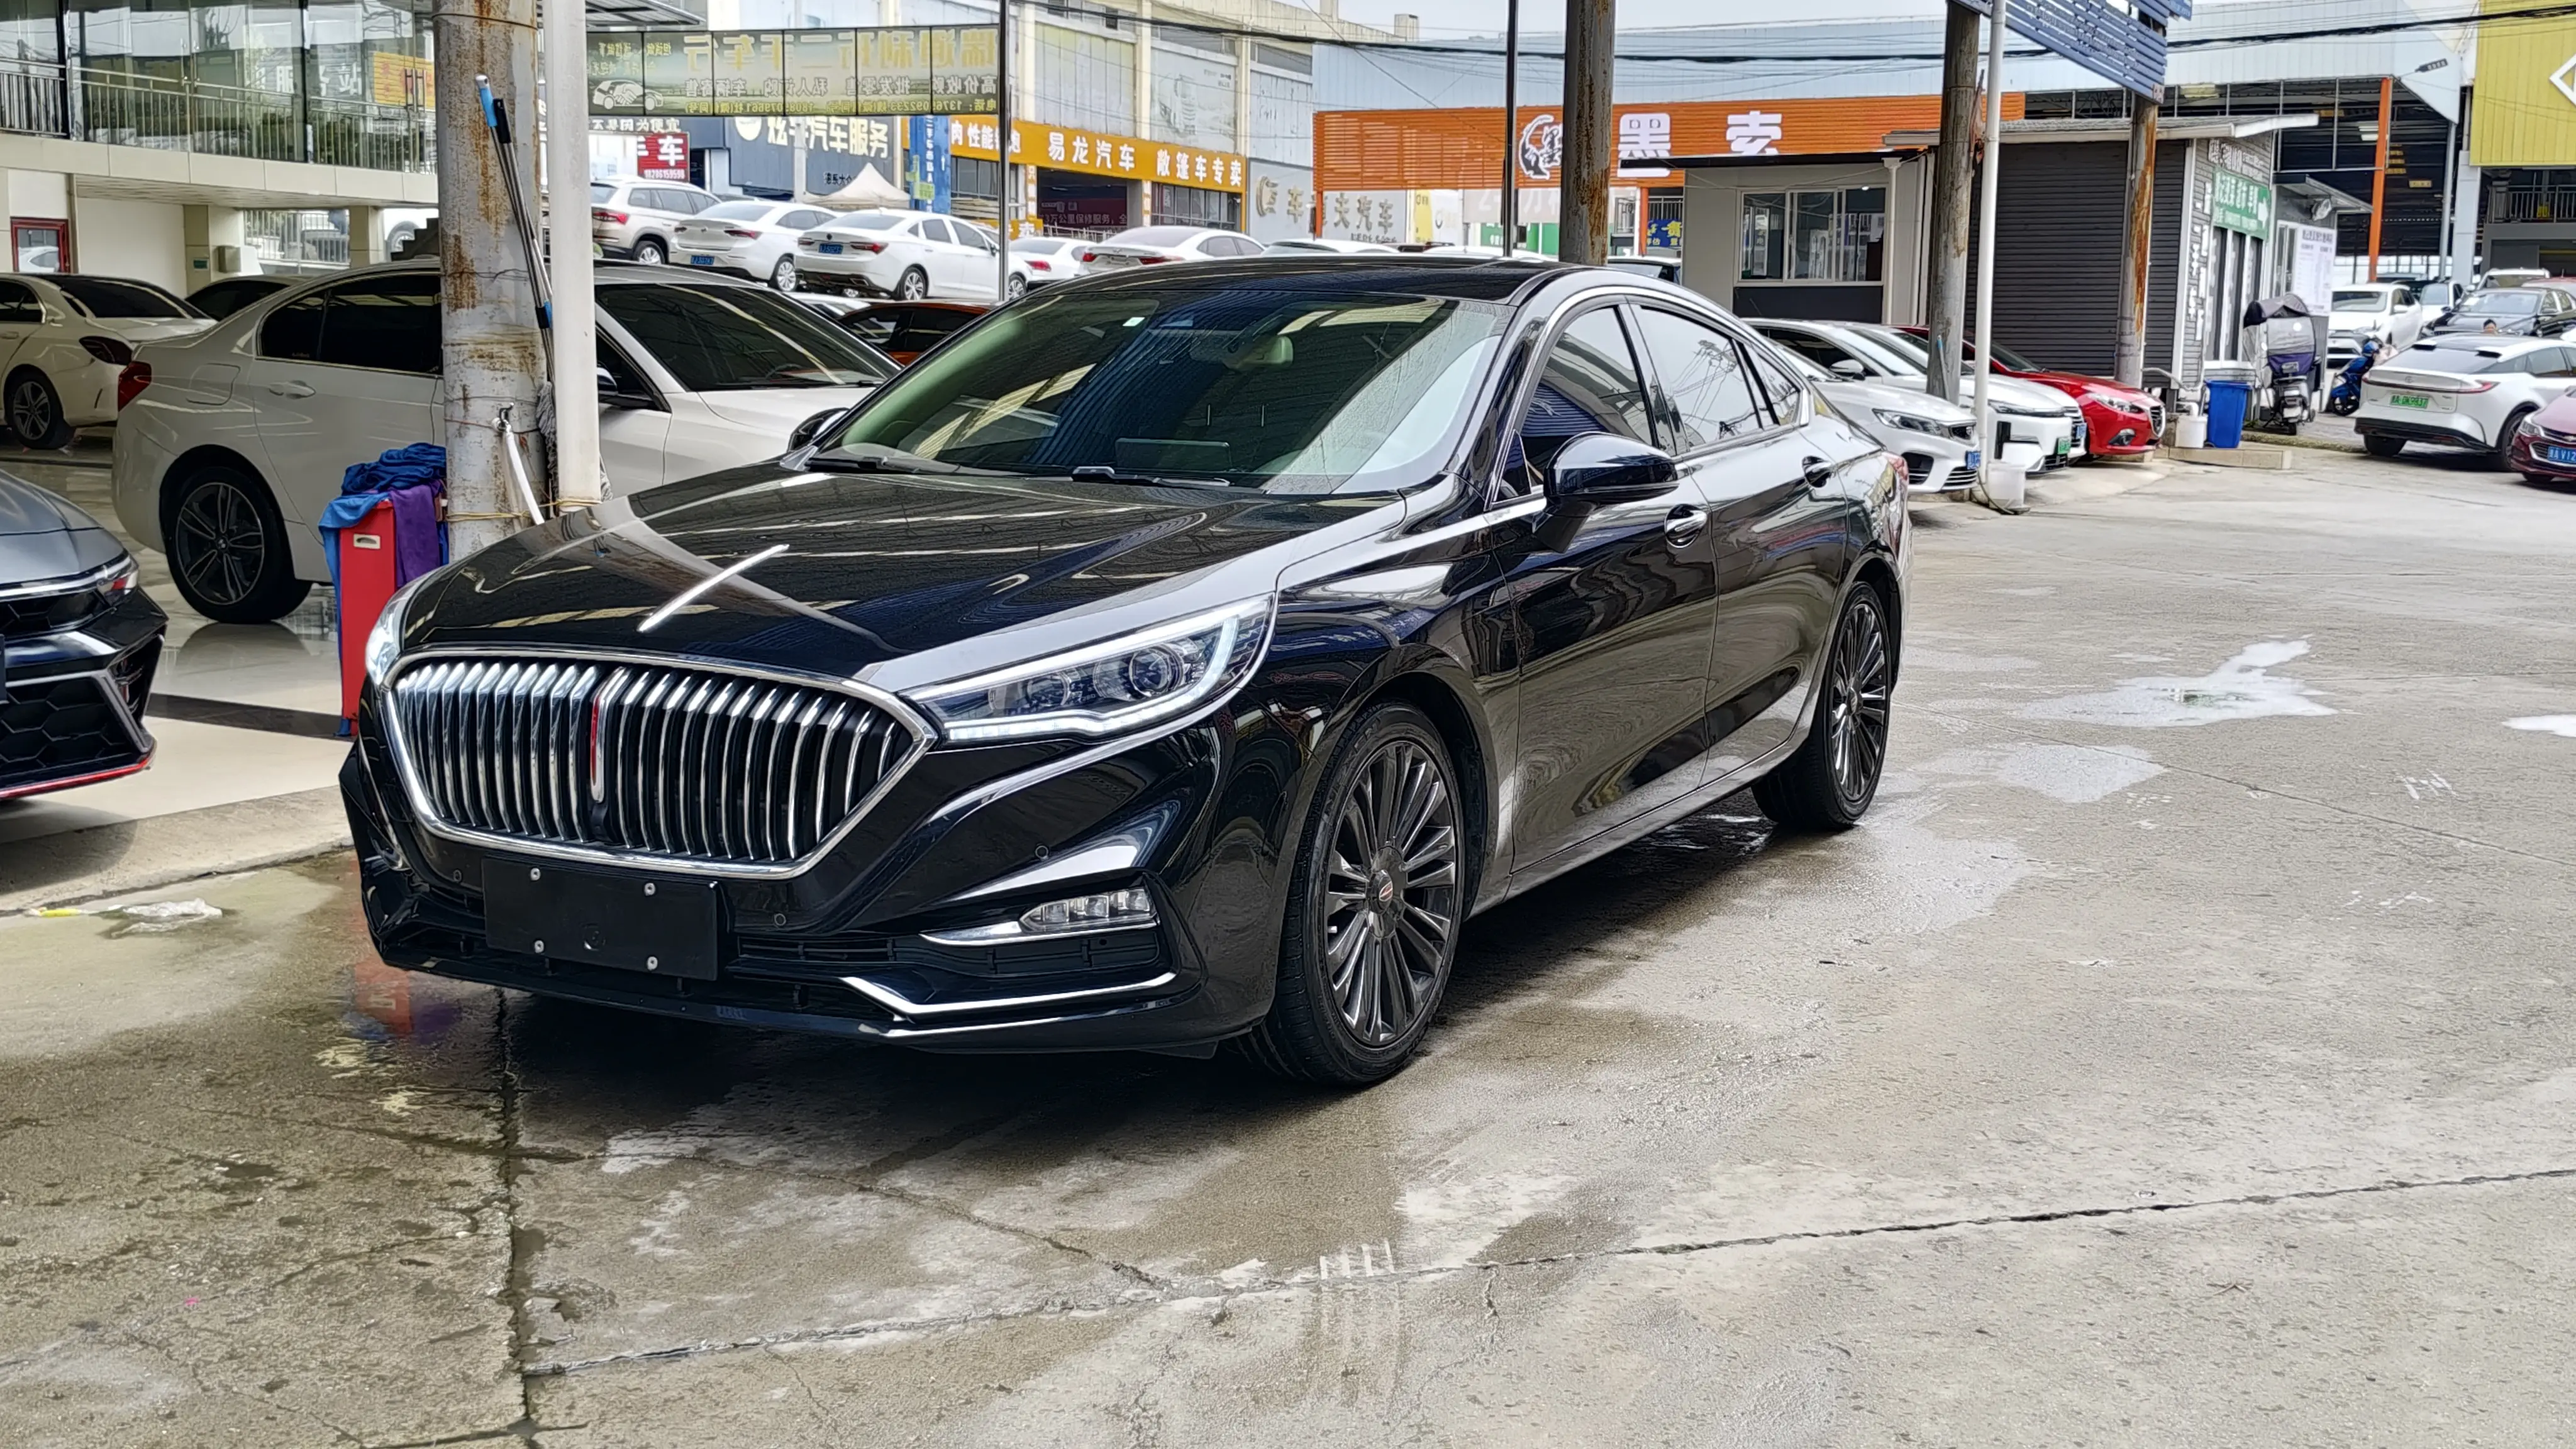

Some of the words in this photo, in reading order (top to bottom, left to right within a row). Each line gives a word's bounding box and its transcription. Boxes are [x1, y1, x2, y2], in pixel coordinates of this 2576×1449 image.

[767, 116, 889, 158] 炫汽车服务
[1048, 130, 1136, 172] 易龙汽车
[1157, 148, 1243, 187] 敞篷车专卖
[1286, 185, 1394, 234] 车夫汽车
